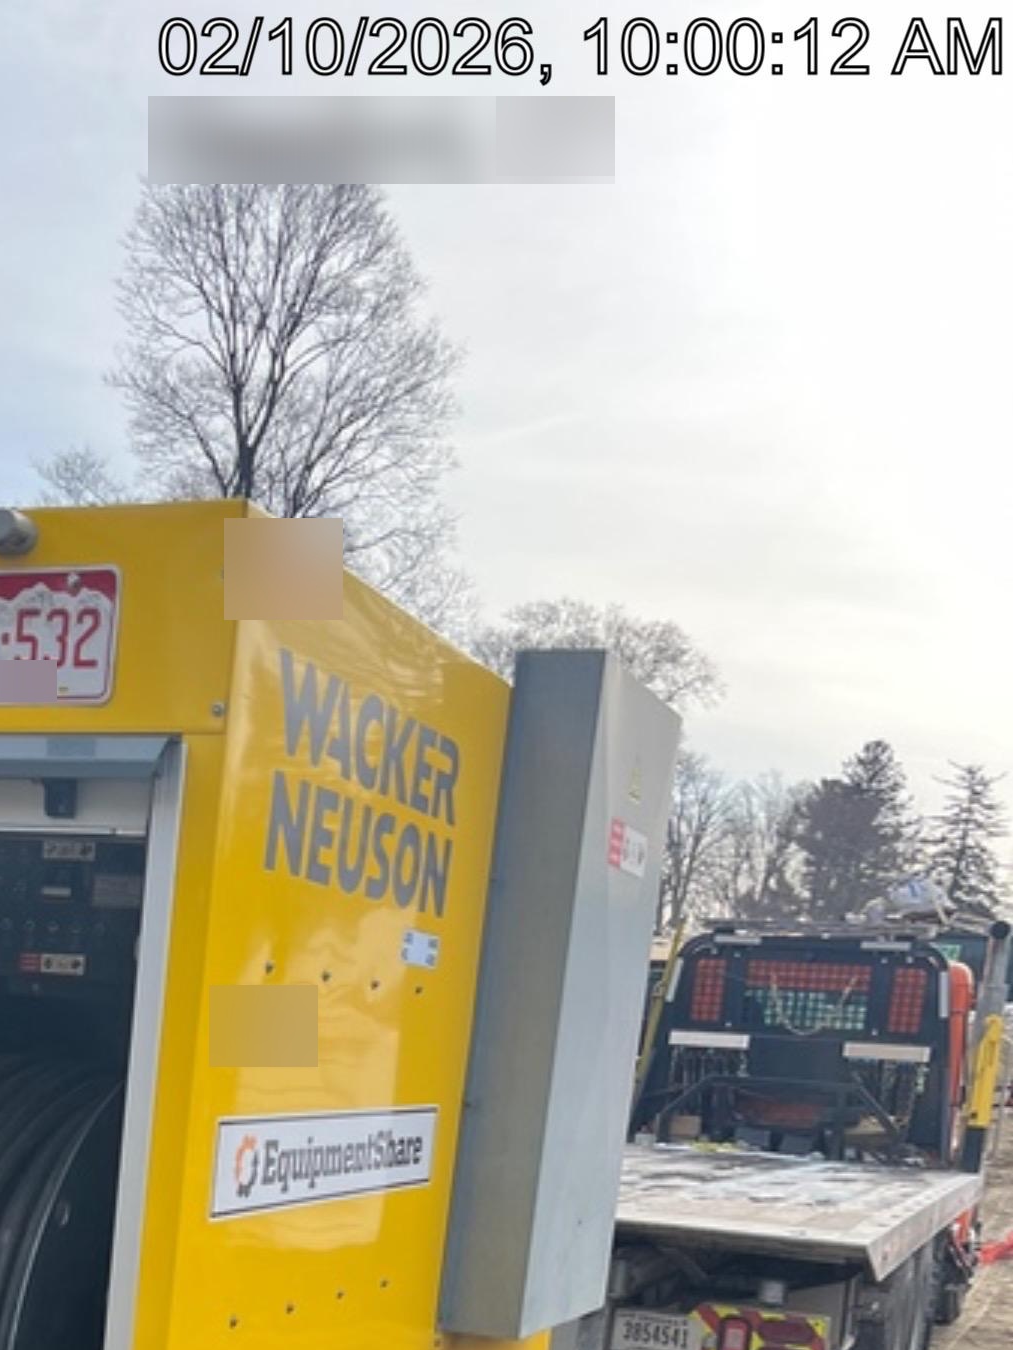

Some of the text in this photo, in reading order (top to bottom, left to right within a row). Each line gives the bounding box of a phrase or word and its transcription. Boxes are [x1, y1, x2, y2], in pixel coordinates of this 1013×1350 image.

[279, 648, 460, 827] WACKER
[264, 770, 453, 918] NEUSON
[260, 1130, 423, 1191] EquipmentShare
